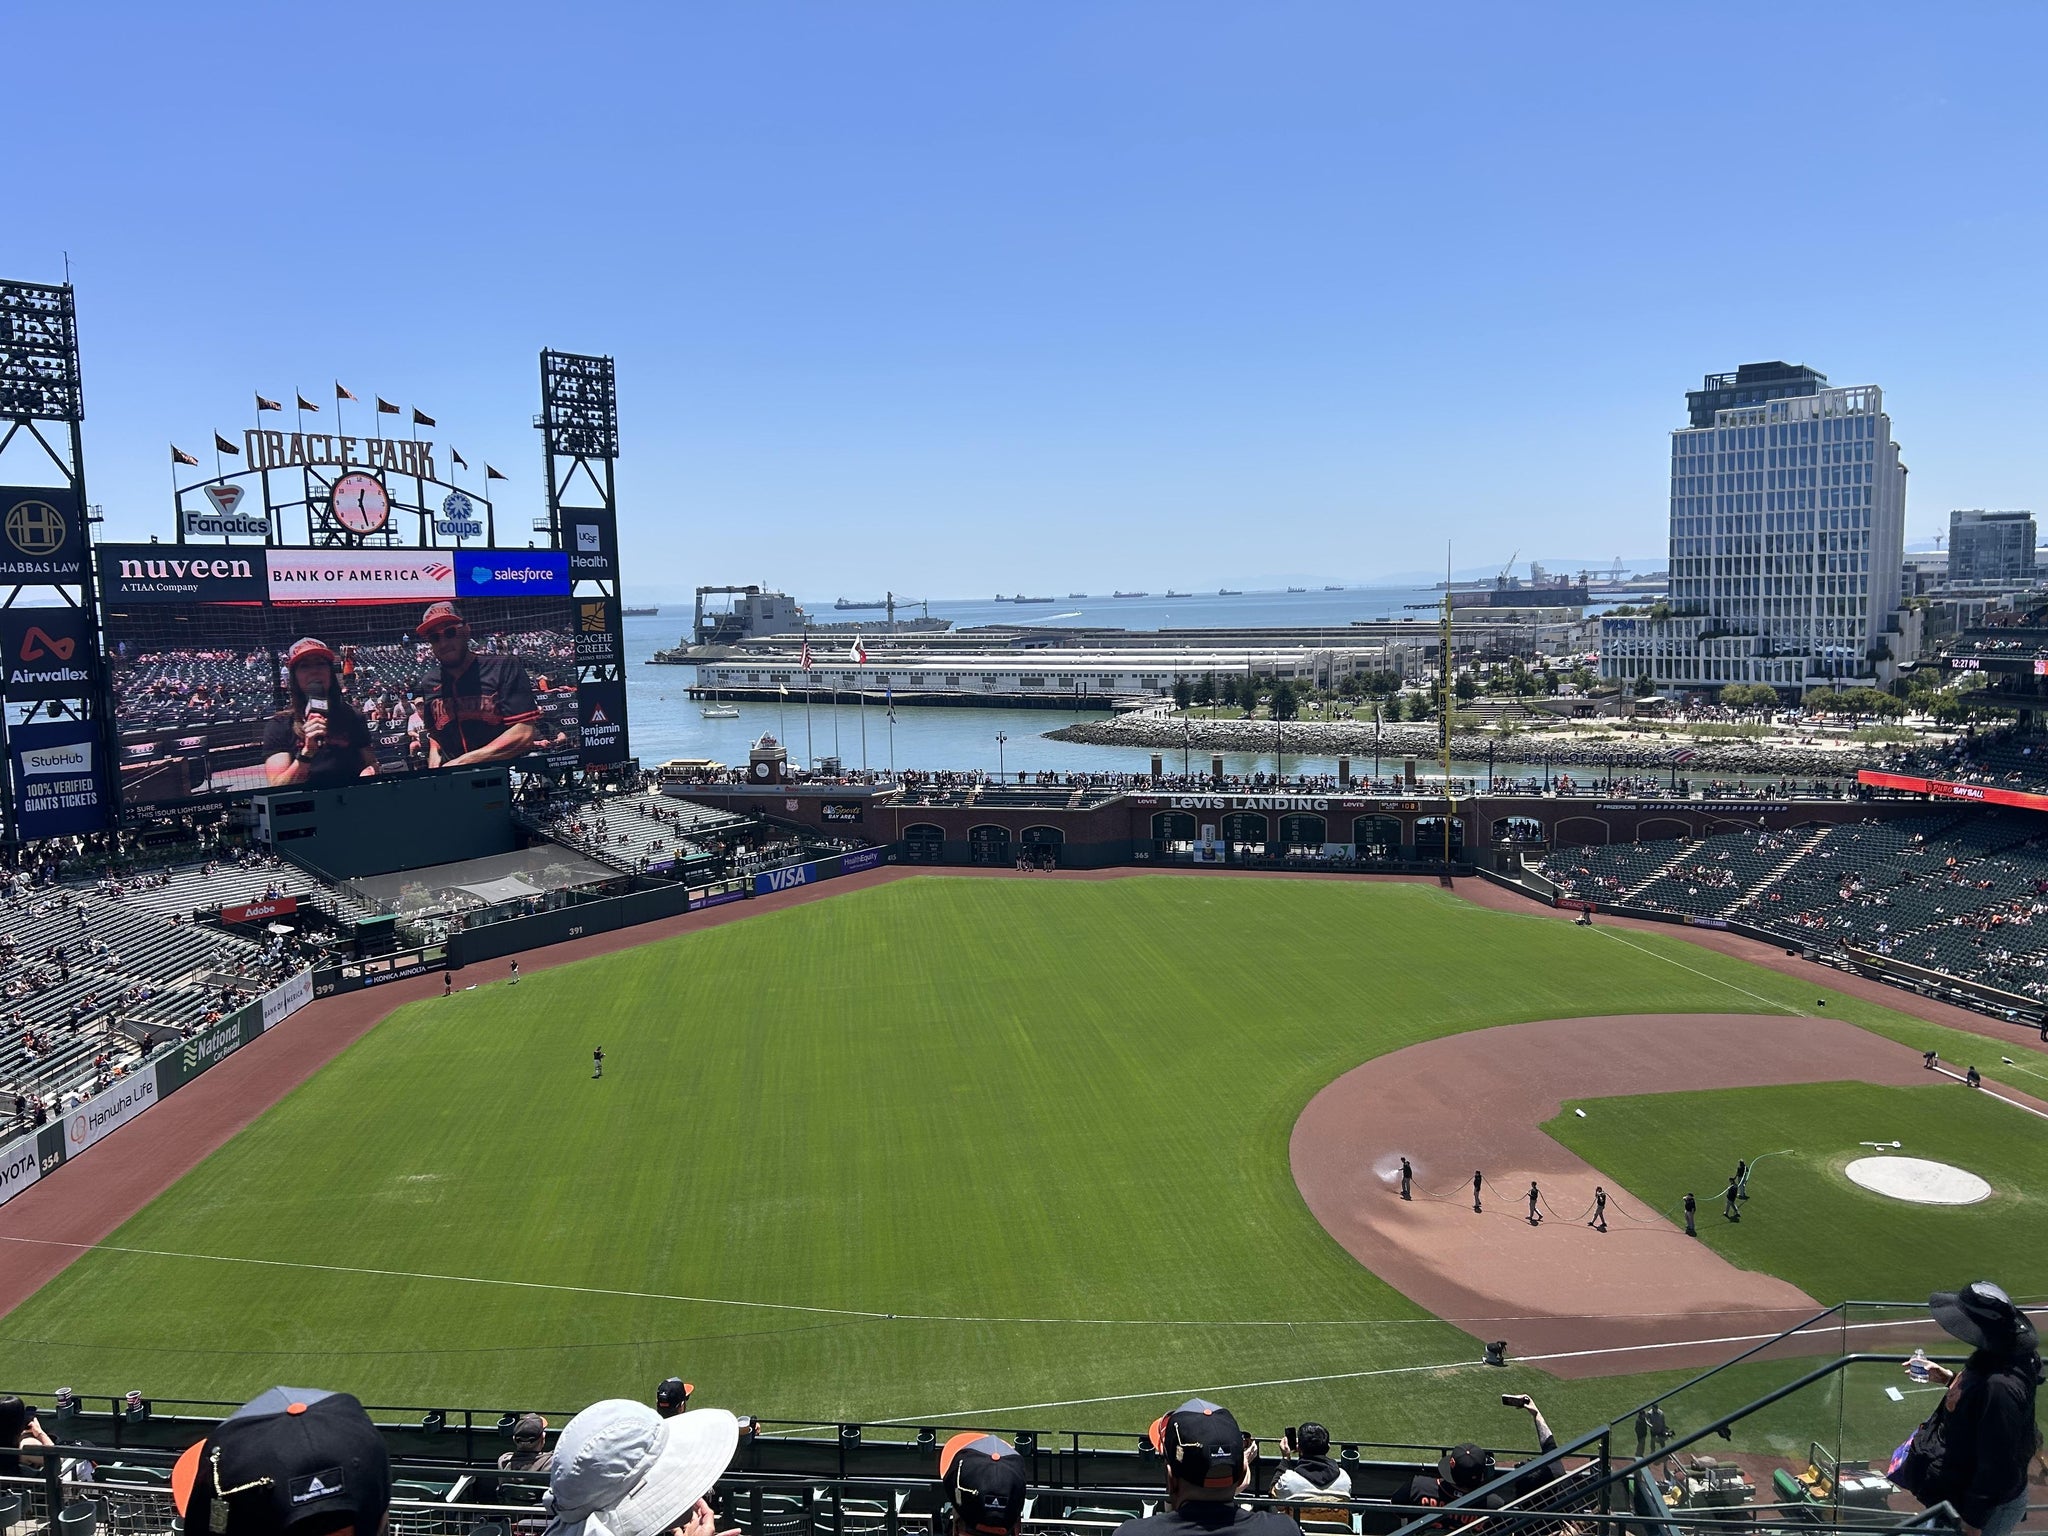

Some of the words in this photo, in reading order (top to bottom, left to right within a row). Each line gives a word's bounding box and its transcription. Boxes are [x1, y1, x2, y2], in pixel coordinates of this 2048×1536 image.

[245, 430, 358, 471] ORACLE
[366, 438, 436, 481] PARK
[187, 514, 268, 533] Fanatics
[440, 522, 480, 538] coupa
[579, 533, 598, 543] UCSF
[0, 562, 50, 573] HABBAS
[53, 562, 80, 573] LAW
[119, 559, 252, 578] nuveen
[571, 555, 608, 568] Health
[273, 570, 319, 581] BANK
[324, 570, 345, 581] OF
[349, 570, 419, 581] AMERICA
[494, 567, 553, 583] salesforce
[121, 583, 129, 591] A
[130, 583, 155, 592] TIAA
[156, 583, 198, 593] Company
[575, 633, 613, 643] CACHE
[577, 643, 612, 653] CREEK
[1952, 659, 1968, 668] 12:27
[1969, 660, 1979, 669] PM
[10, 668, 88, 684] Airwallex
[581, 723, 620, 736] Benjamin
[31, 753, 83, 768] StubHub
[1524, 753, 1564, 762] BANK
[1569, 753, 1586, 762] OF
[1592, 753, 1660, 762] AMERICA
[26, 782, 52, 797] 100%
[53, 778, 94, 794] VERIFIED
[24, 796, 59, 812] GIANTS
[61, 793, 98, 808] TICKETS
[1232, 798, 1329, 810] LANDING
[137, 811, 154, 819] THIS
[177, 803, 223, 814] LIGHTSABERS
[844, 852, 878, 865] HealthEquity
[767, 866, 806, 891] VISA
[245, 906, 276, 917] Adobe
[569, 926, 583, 935] 391
[373, 972, 398, 983] KONICA
[399, 966, 427, 977] MINOLTA
[316, 984, 335, 995] 399
[198, 1017, 241, 1060] National
[89, 1095, 132, 1130] Hanwha
[133, 1082, 153, 1102] Life
[42, 1151, 59, 1171] 354
[0, 1154, 35, 1187] YOTA
